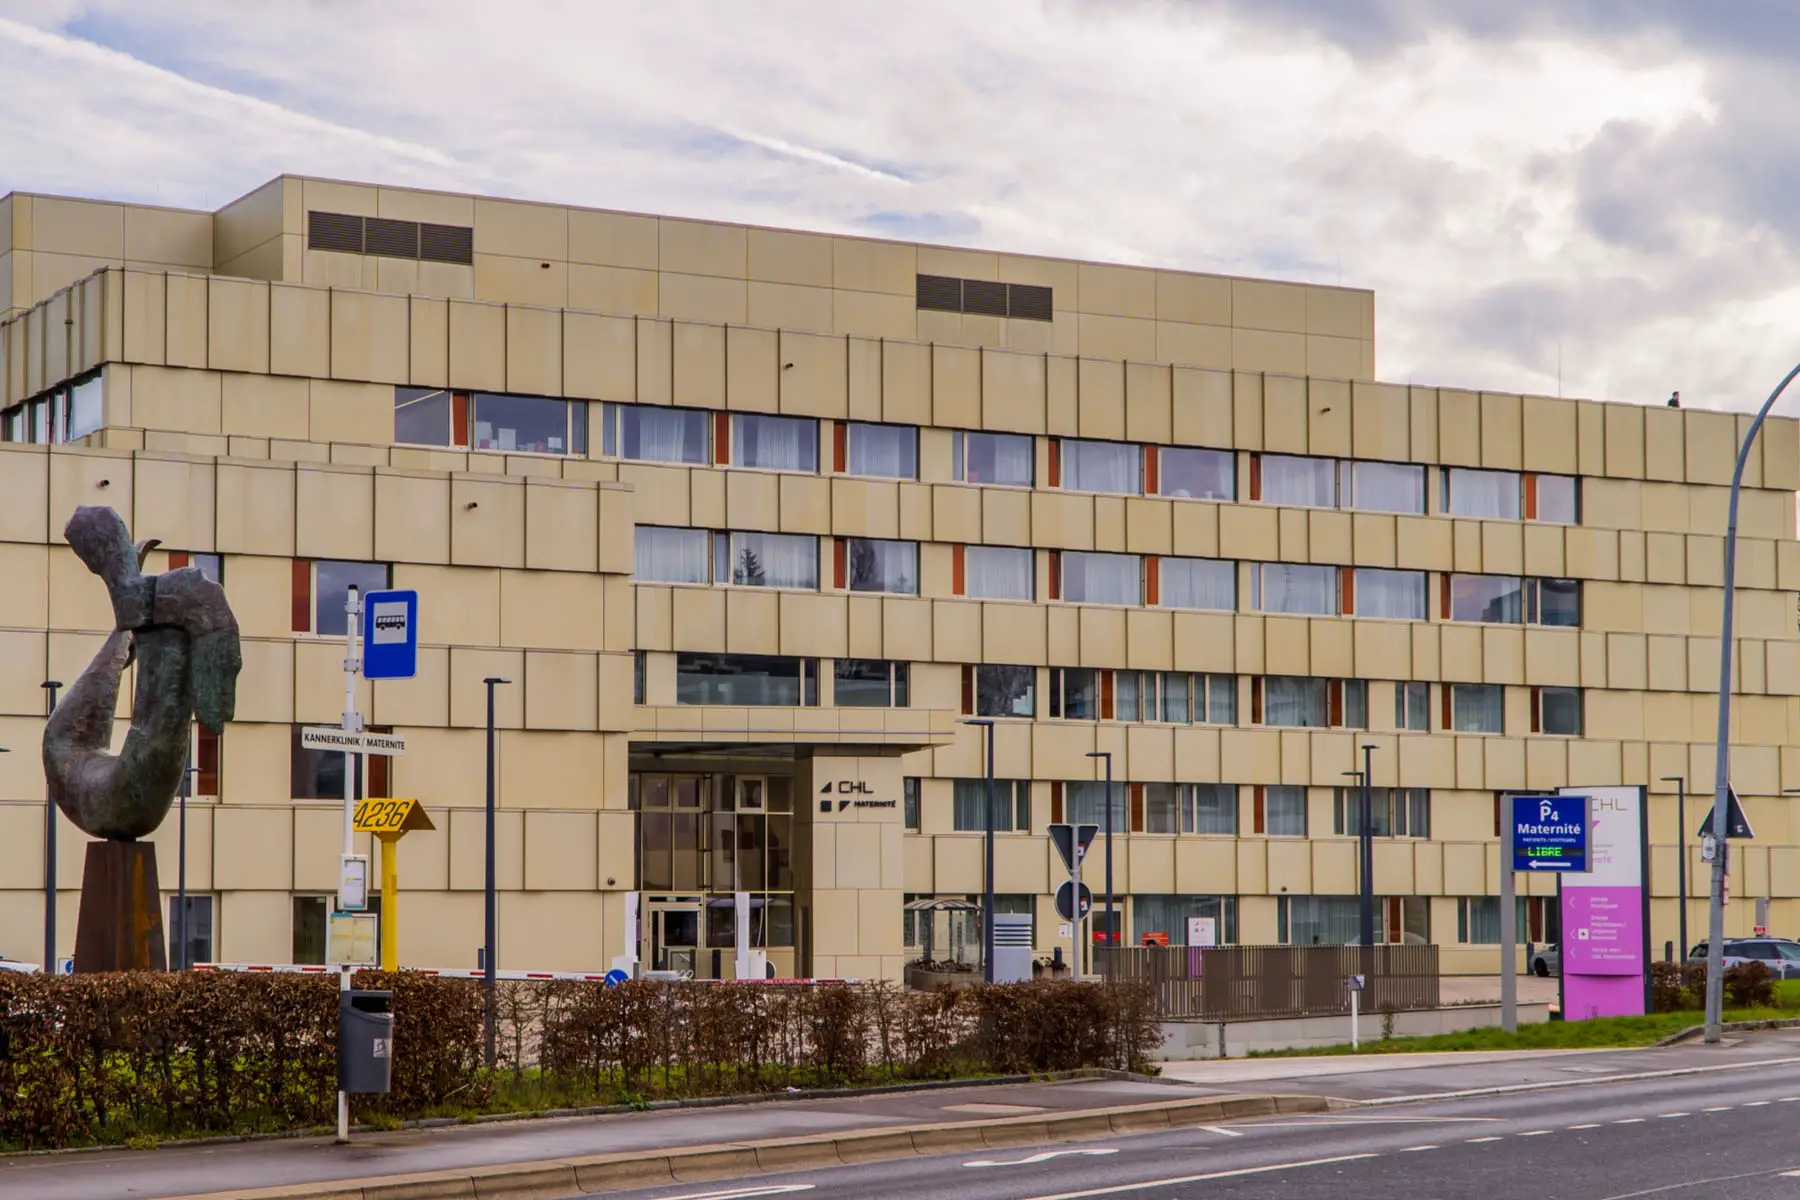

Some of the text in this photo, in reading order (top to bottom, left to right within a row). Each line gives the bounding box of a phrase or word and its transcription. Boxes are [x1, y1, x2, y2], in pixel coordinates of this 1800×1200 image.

[304, 733, 360, 746] KANNERKLINIK
[366, 739, 405, 750] MATERNITE
[838, 781, 874, 793] CHL
[353, 801, 409, 828] 4236
[1517, 823, 1581, 835] Maternité
[1527, 846, 1562, 857] LIBRE
